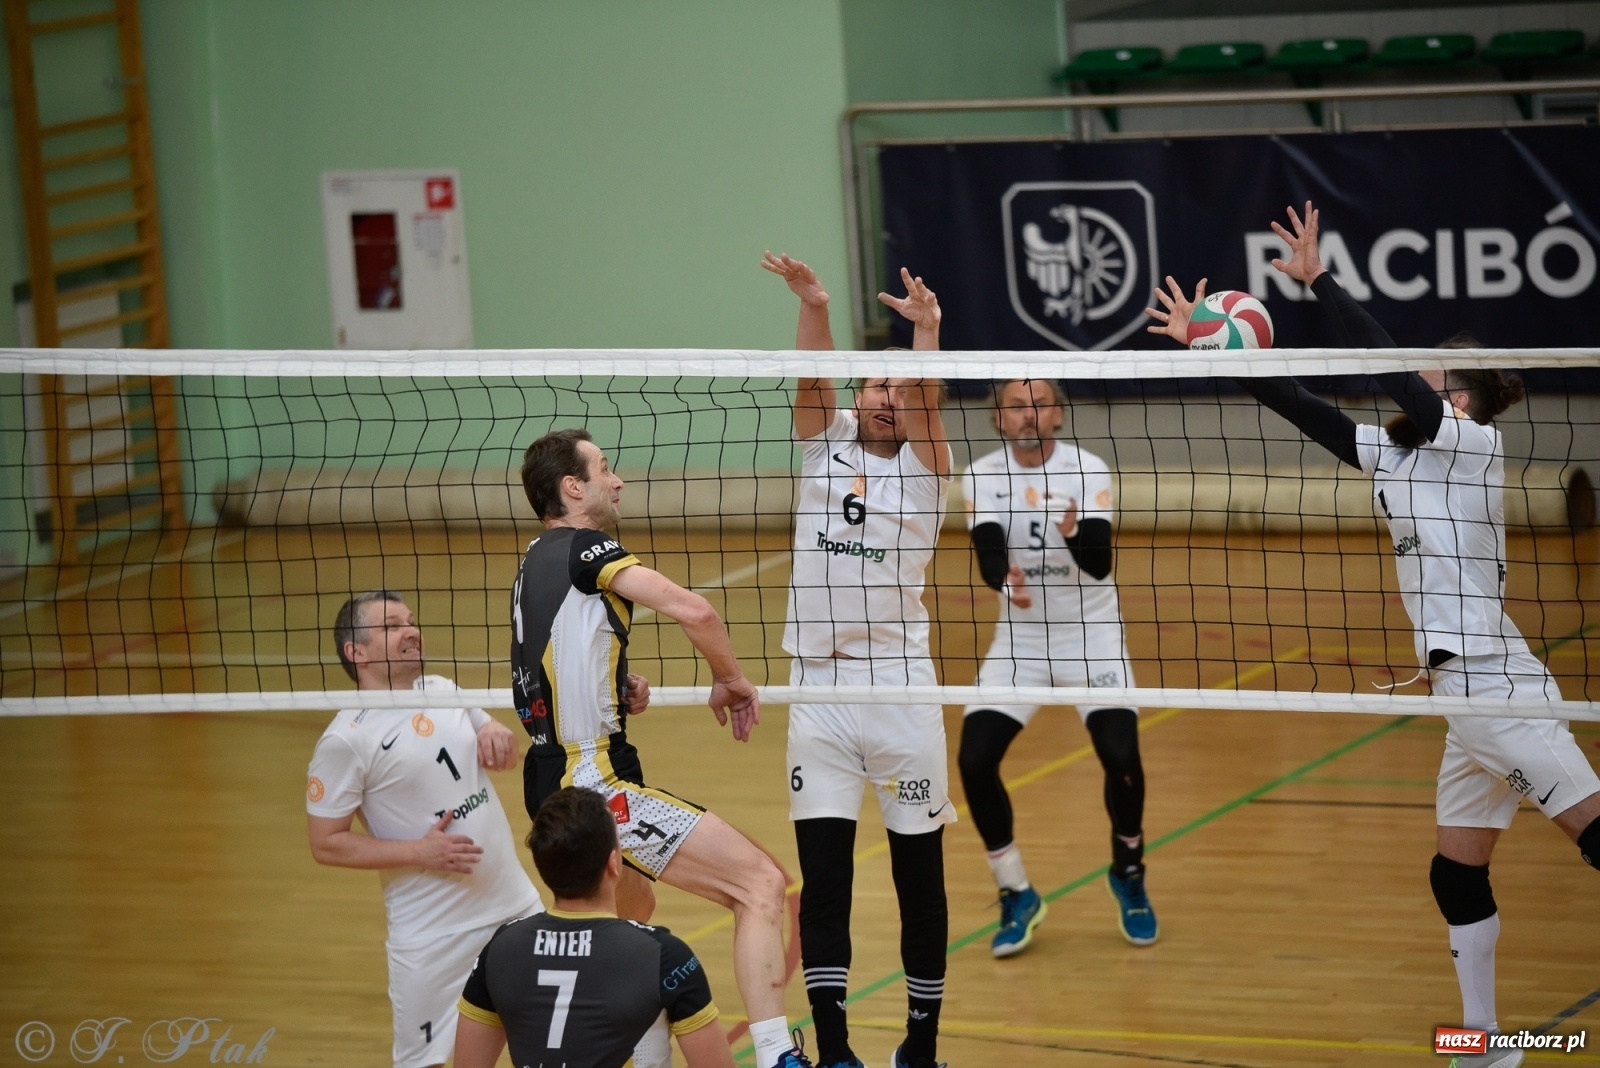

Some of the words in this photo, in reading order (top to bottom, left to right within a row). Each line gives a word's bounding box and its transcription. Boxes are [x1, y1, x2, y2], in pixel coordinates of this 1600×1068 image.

[1244, 201, 1597, 301] RACIBÓ
[842, 493, 866, 526] 6
[817, 531, 887, 563] TropiDog
[1029, 522, 1045, 551] 5
[436, 747, 461, 782] 1
[791, 766, 803, 792] 6
[898, 779, 931, 791] ZOO
[898, 790, 931, 801] MAR
[434, 787, 489, 822] TopiDog
[631, 819, 667, 841] 4
[533, 929, 593, 957] ENTER
[537, 969, 579, 1049] 7
[420, 1021, 432, 1043] 1
